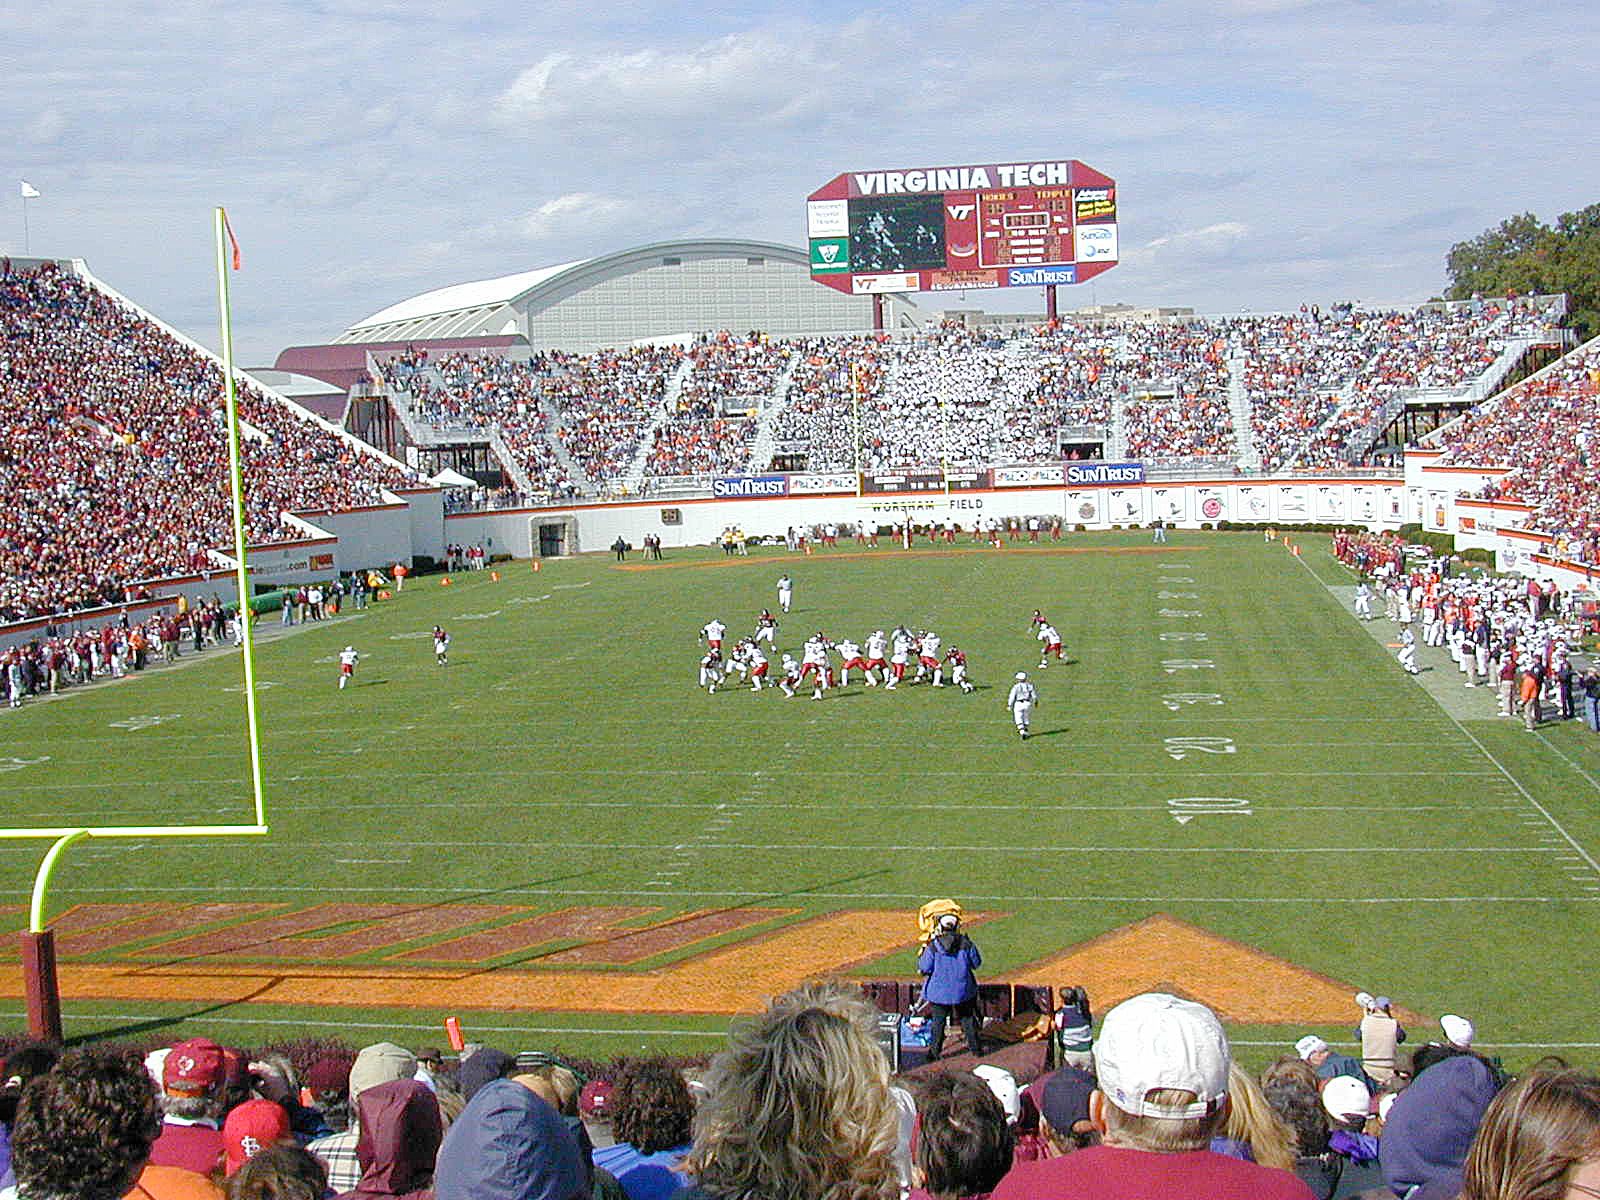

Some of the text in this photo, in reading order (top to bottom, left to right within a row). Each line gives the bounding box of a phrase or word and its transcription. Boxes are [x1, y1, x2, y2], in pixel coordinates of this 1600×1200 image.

[855, 162, 1068, 195] VIRGINIA TECH
[1036, 189, 1072, 199] TEMPLE
[947, 204, 975, 220] VT
[856, 278, 877, 290] VT
[950, 499, 983, 510] FIELD
